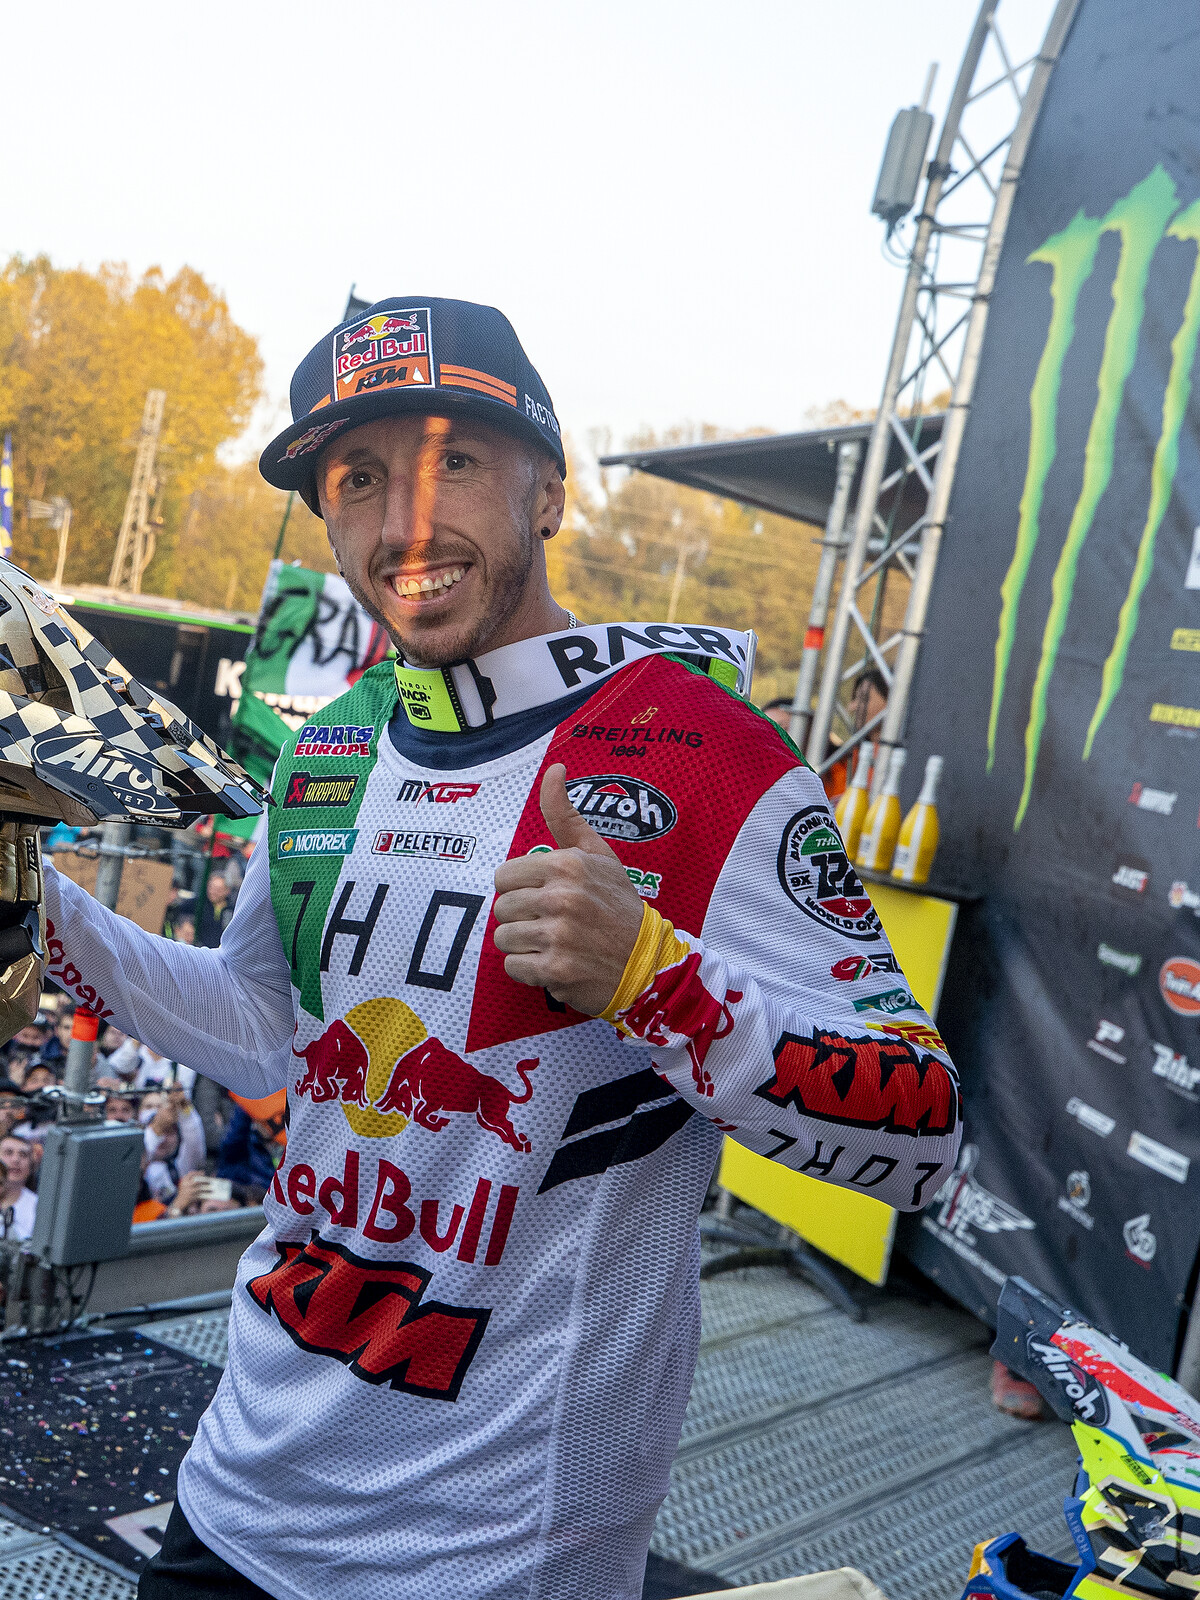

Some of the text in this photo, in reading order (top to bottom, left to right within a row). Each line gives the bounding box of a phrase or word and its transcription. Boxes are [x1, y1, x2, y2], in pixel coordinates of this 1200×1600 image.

[337, 333, 427, 375] Red Bull
[355, 366, 409, 393] KTM
[299, 725, 375, 745] PARTS
[571, 724, 704, 750] BREITLING
[293, 742, 371, 758] EUROPE
[609, 745, 648, 759] 1884
[397, 780, 482, 804] MXGP
[568, 783, 663, 829] Airoh
[294, 833, 352, 852] MOTOREX
[393, 833, 464, 855] PELETTO
[790, 875, 812, 887] 9X
[804, 895, 854, 930] WORLD
[752, 1026, 961, 1138] KTM
[362, 1158, 520, 1267] Bull
[246, 1229, 492, 1402] KTM
[1031, 1341, 1101, 1420] Airoh
